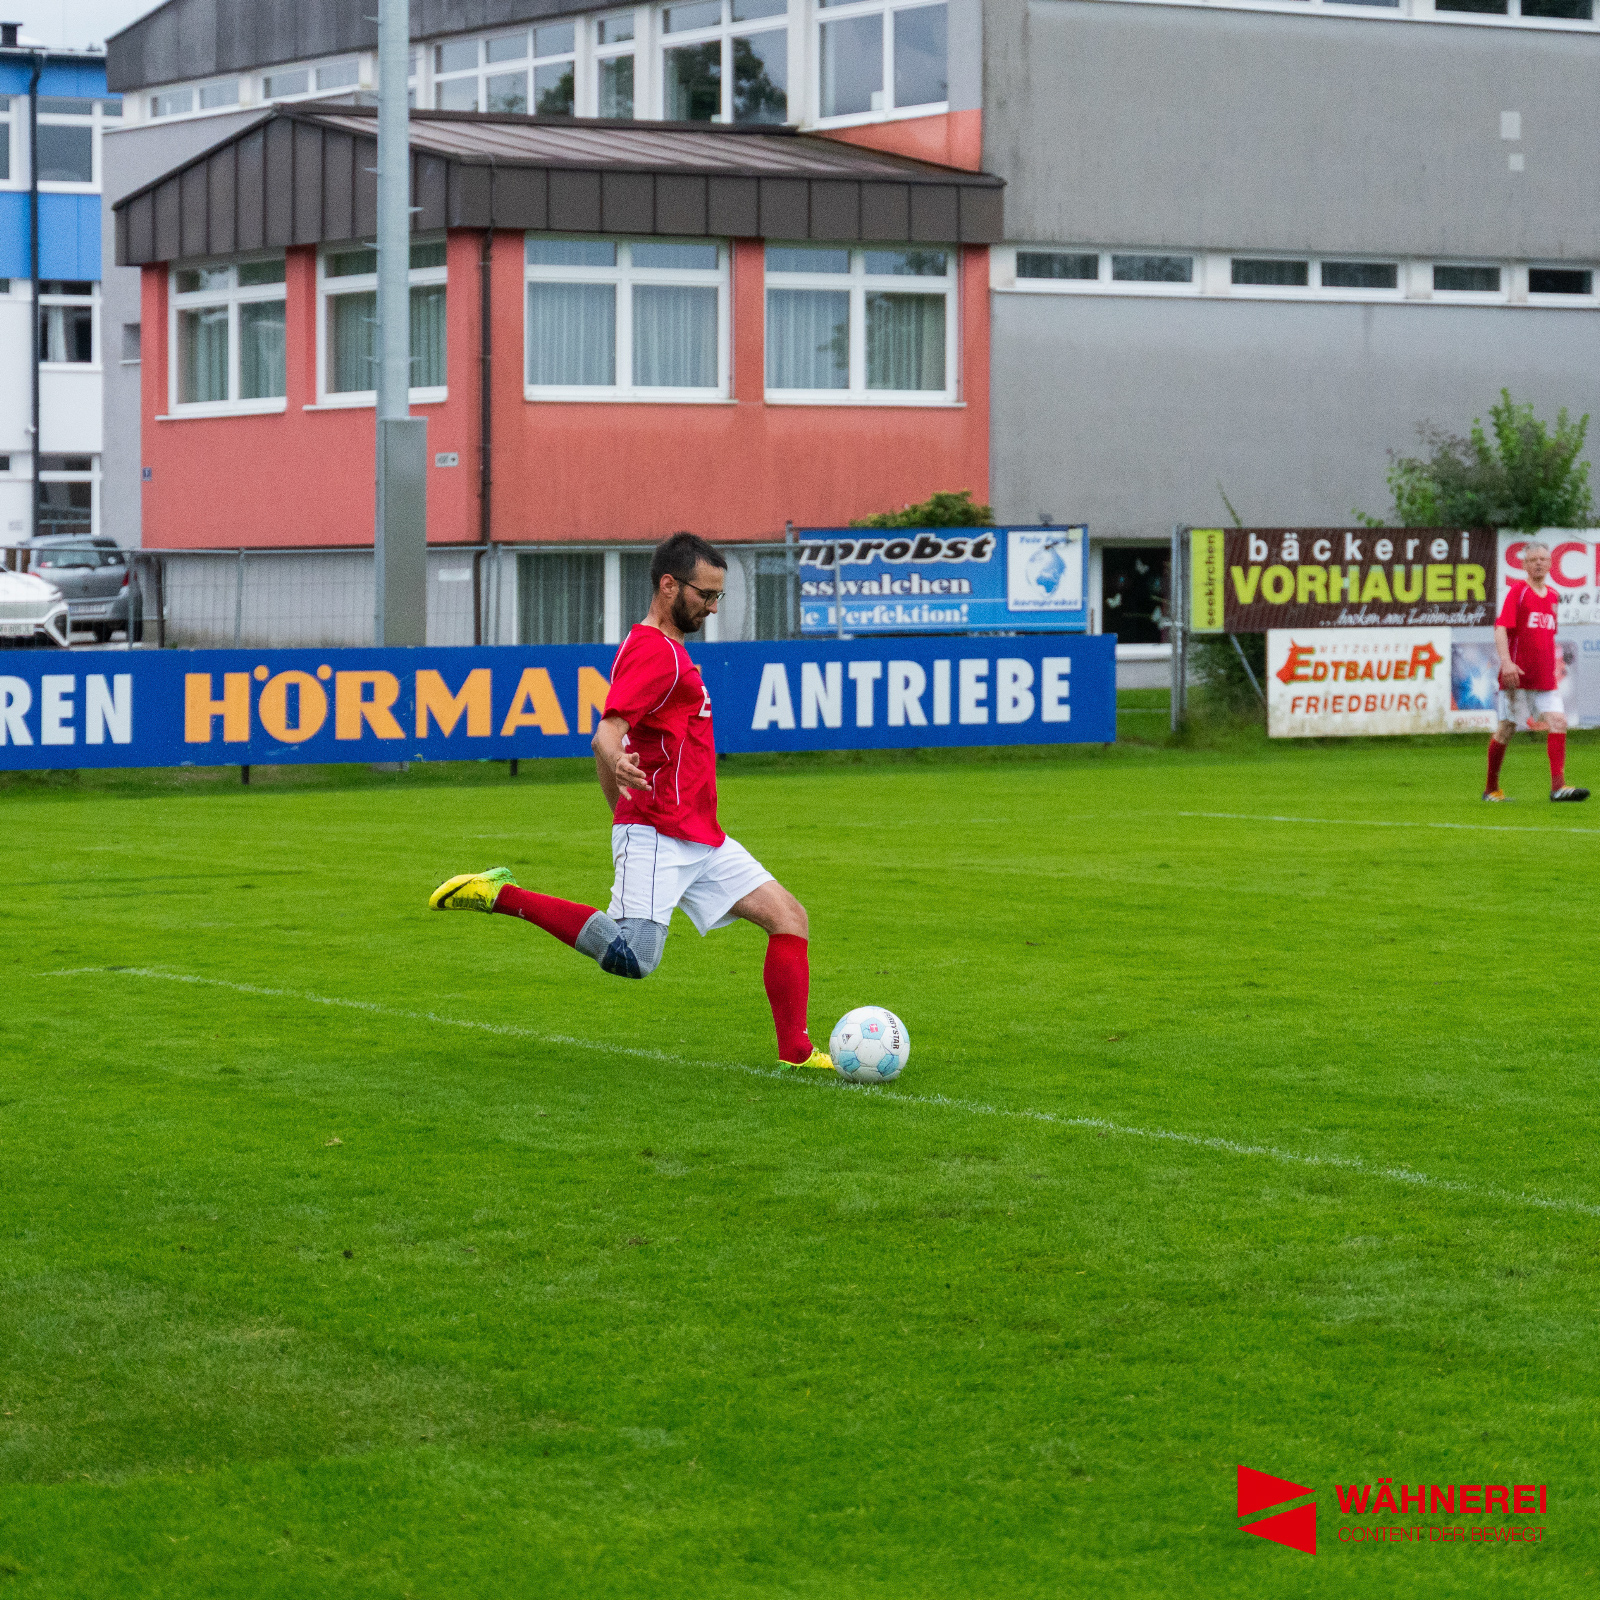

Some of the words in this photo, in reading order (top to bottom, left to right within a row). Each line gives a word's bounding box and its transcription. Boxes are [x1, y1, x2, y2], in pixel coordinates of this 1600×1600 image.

[1248, 531, 1470, 562] bäckerei
[1505, 541, 1600, 588] SC
[1204, 534, 1217, 627] seekirchen
[1230, 563, 1487, 605] VORHAUER
[828, 603, 969, 625] Perfektion!
[1276, 638, 1443, 685] EDTBAUER
[0, 673, 132, 746] REN
[184, 664, 701, 743] HÖRMAN
[751, 656, 1072, 731] ANTRIEBE
[1291, 692, 1429, 714] FRIEDBURG
